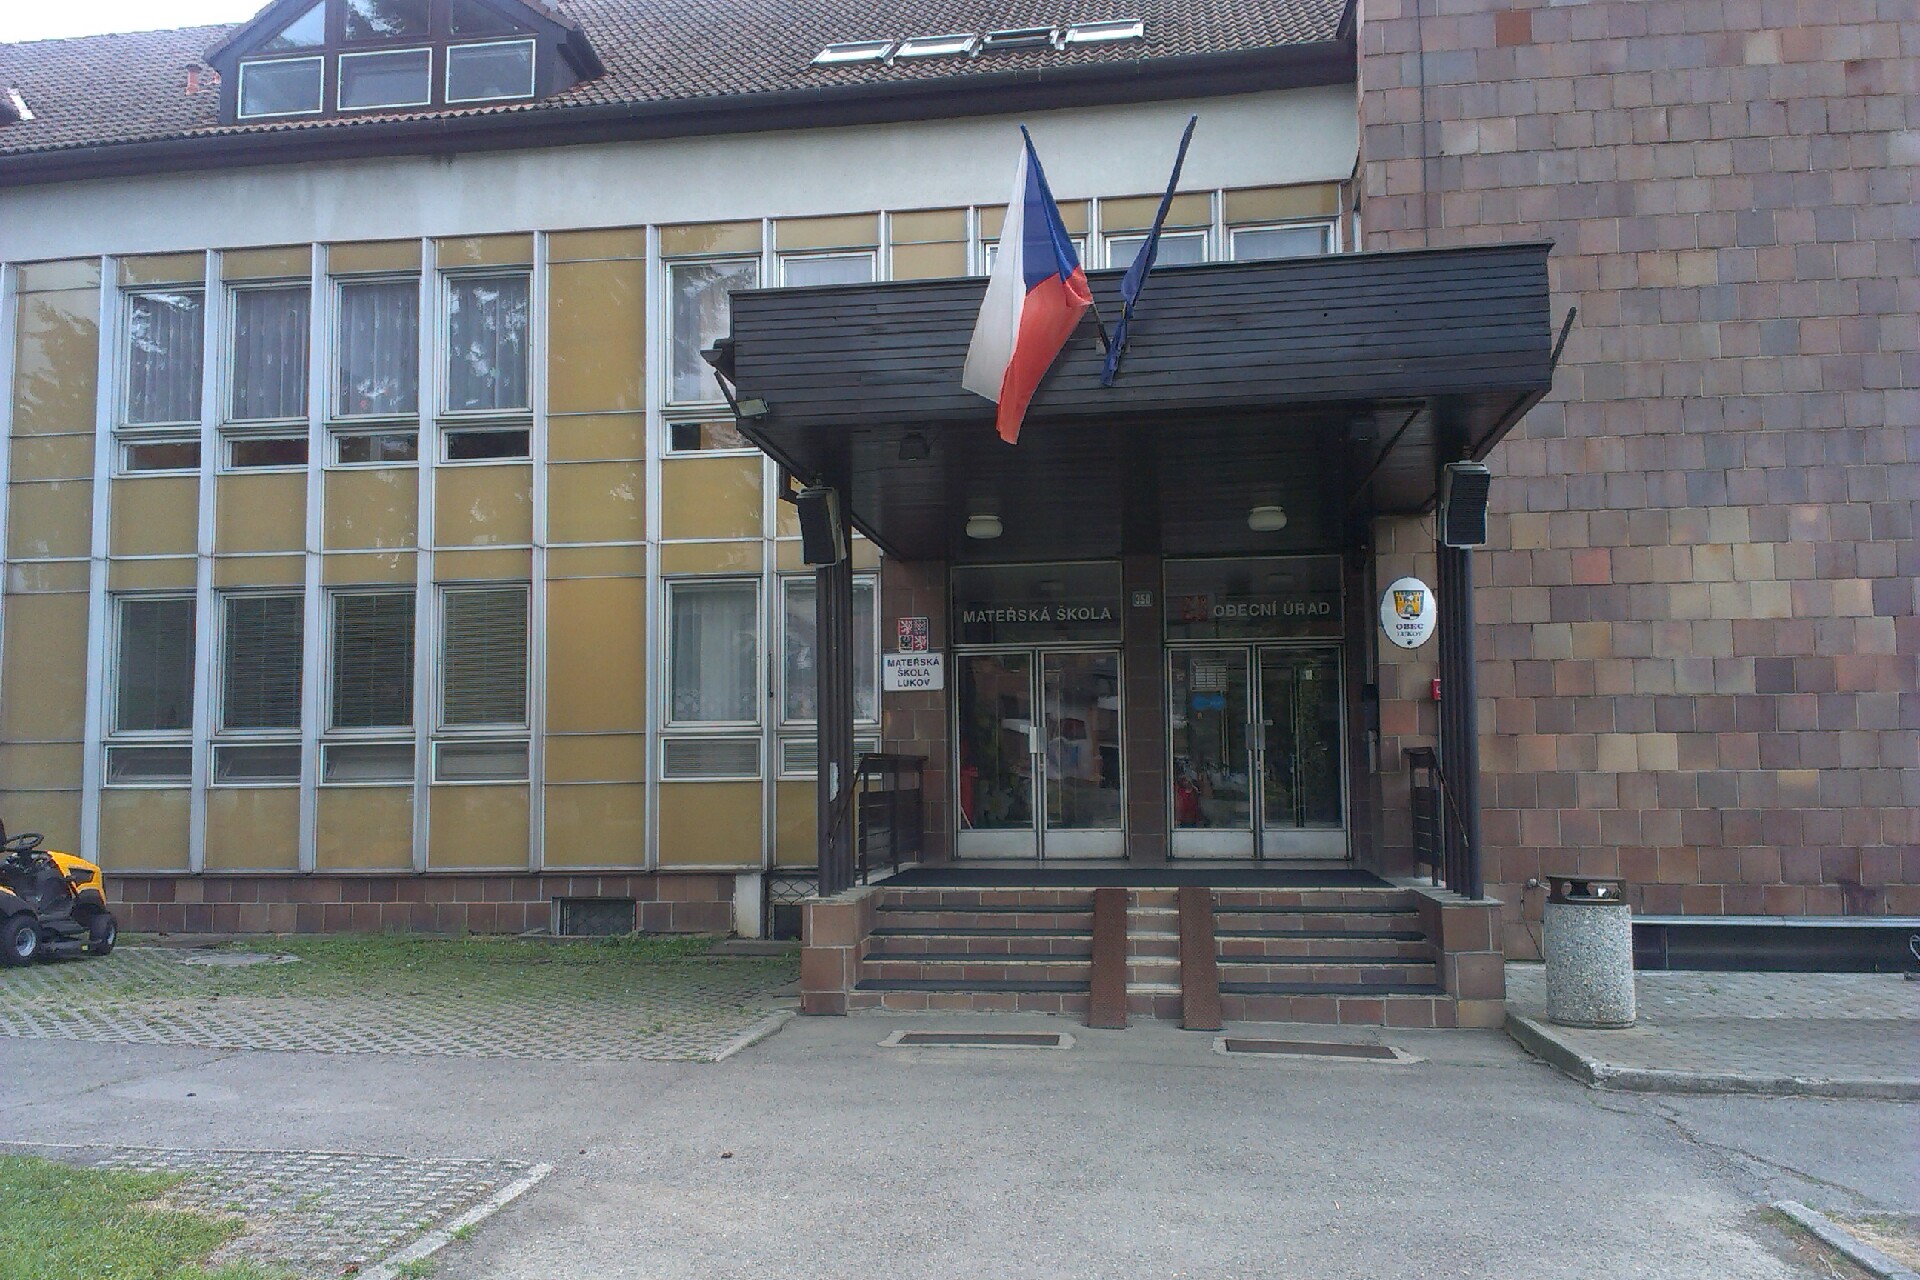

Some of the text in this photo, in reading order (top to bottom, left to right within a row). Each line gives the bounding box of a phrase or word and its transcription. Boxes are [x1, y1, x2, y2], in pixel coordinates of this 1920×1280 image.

[963, 604, 1112, 624] MATEŘSKÁ ŠKOLA
[1213, 600, 1277, 617] OBECNÍ
[1395, 623, 1425, 631] OBEC
[887, 656, 940, 668] MATEŘSKÁ
[897, 667, 930, 677] ŠKOLA
[897, 678, 931, 688] LUKOV
